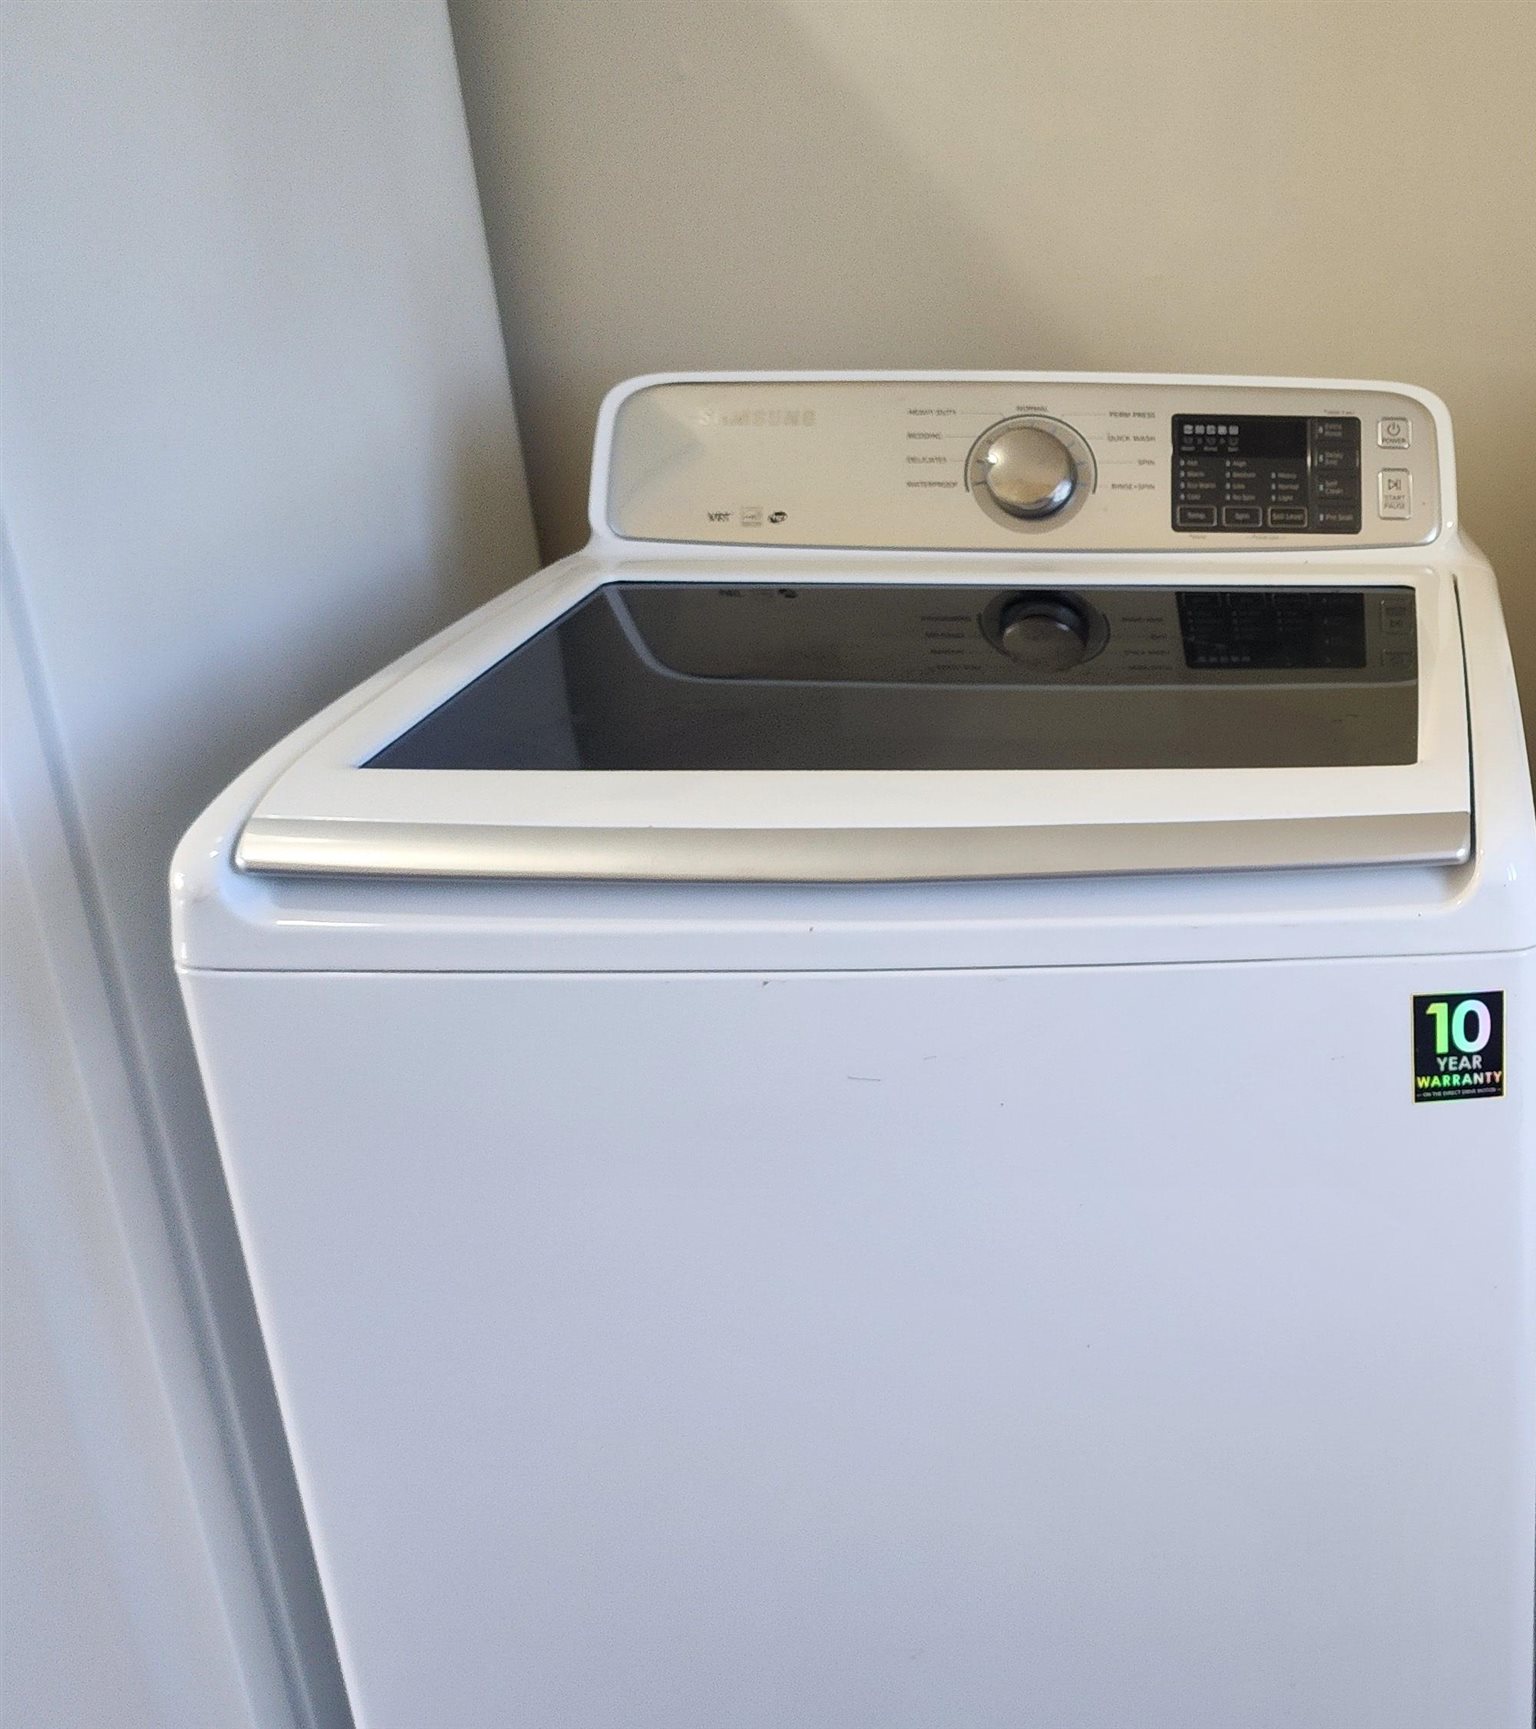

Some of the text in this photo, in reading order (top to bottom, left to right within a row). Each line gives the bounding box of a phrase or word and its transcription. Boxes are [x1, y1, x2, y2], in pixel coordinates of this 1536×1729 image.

[697, 408, 817, 426] SAMSUNG
[1425, 999, 1492, 1055] 10
[1436, 1054, 1482, 1072] YEAR
[1416, 1071, 1503, 1089] WARRANTY
